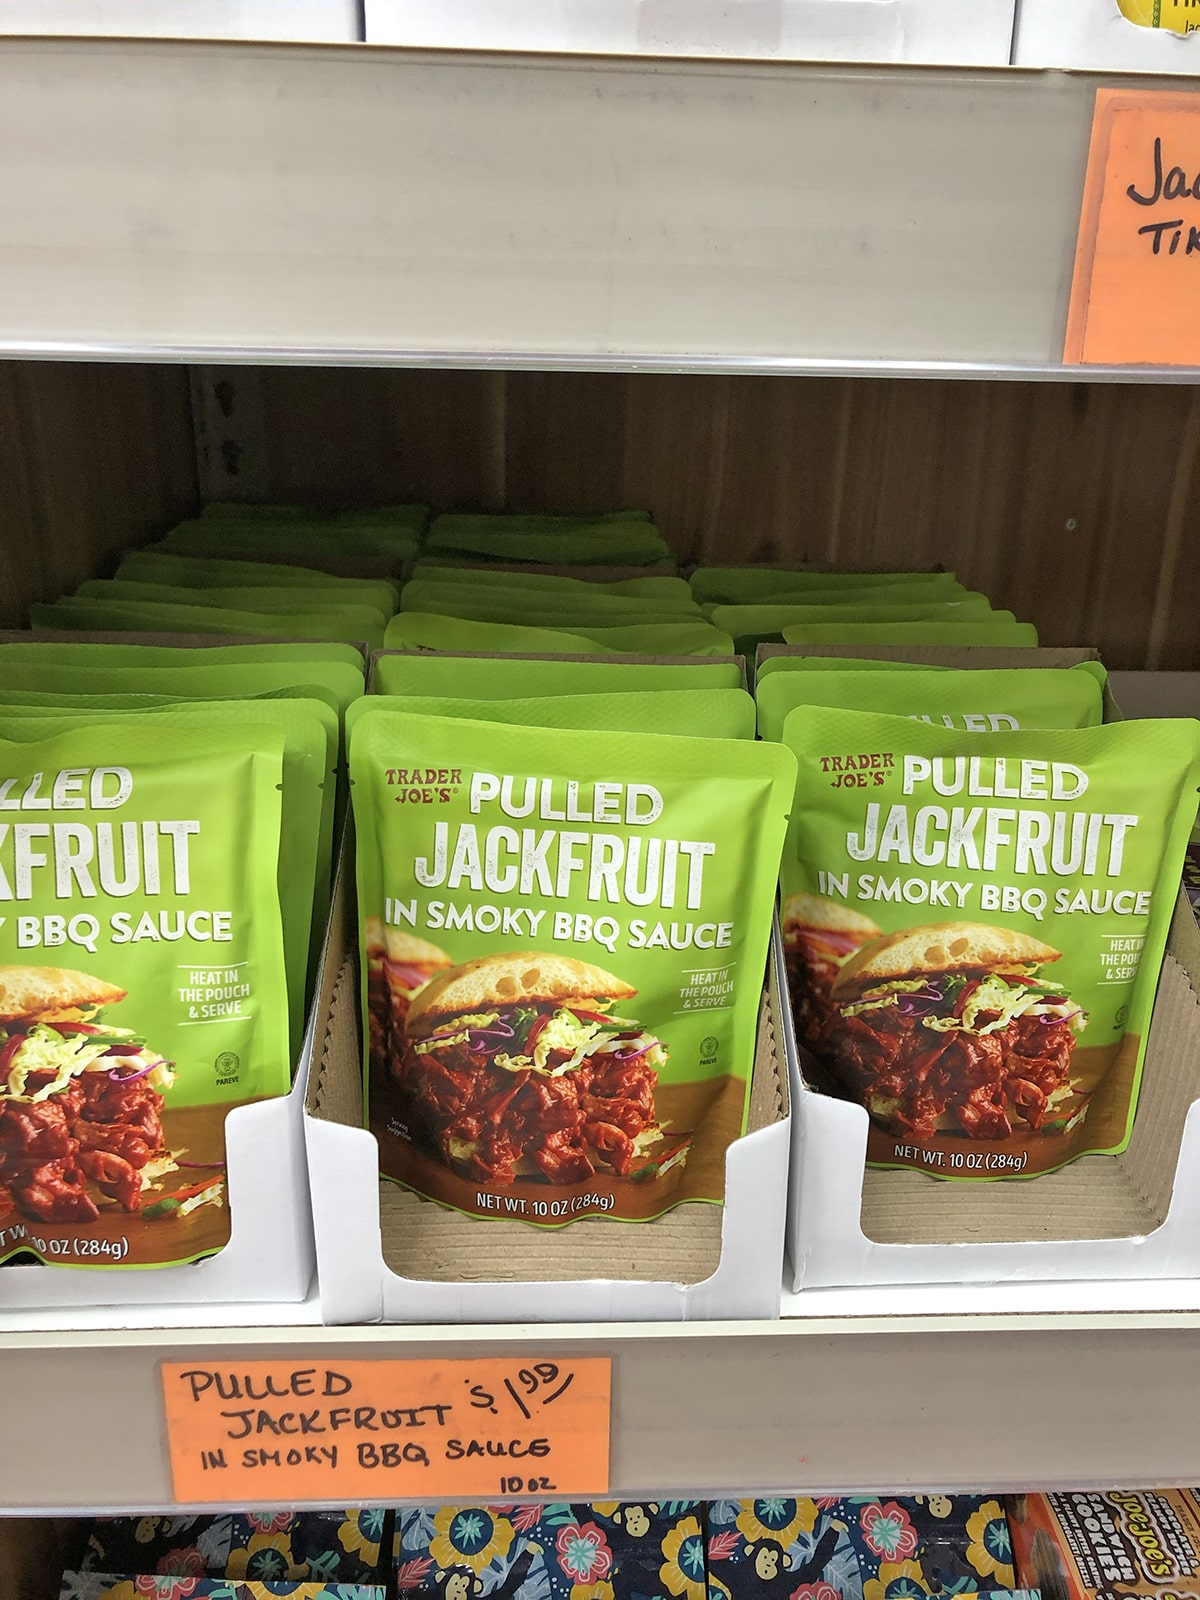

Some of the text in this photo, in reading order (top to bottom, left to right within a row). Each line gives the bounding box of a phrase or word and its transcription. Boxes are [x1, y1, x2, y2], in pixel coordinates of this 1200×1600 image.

[820, 753, 895, 772] TRADER
[385, 769, 463, 785] TRADER
[902, 754, 1089, 801] PULLED
[470, 772, 664, 825] PULLED
[846, 803, 1138, 877] JACKFRUIT
[415, 822, 716, 909] JACKFRUIT
[818, 871, 1152, 921] IN SMOKY BBQ SAUCE
[18, 910, 233, 952] BBQ SAUCE
[385, 897, 734, 953] IN SMOKY BBQ SAUCE
[1110, 939, 1136, 951] HEAT
[1100, 953, 1119, 966] THE
[190, 969, 239, 985] HEAT IN
[690, 969, 728, 985] HEAT IN
[1106, 969, 1113, 979] &
[178, 984, 250, 1002] THE POUCH
[680, 981, 734, 998] THE POUCH
[189, 1000, 242, 1018] & SERVE
[683, 996, 727, 1008] & SERVE
[216, 1076, 240, 1086] PAREVE
[894, 1145, 1028, 1171] NET WT. 10 OZ (284g)
[476, 1192, 615, 1216] NET WT. 10 OZ (284g)
[49, 1239, 71, 1254] OZ
[73, 1236, 129, 1260] (284g)
[180, 1369, 352, 1401] PULLED
[221, 1404, 453, 1439] JACKFRUIT
[201, 1438, 551, 1470] IN SMOKY BBQ SAUCE
[500, 1476, 522, 1493] 10
[1071, 1493, 1122, 1582] COOKIES
[1086, 1493, 1136, 1581] SANDWICH
